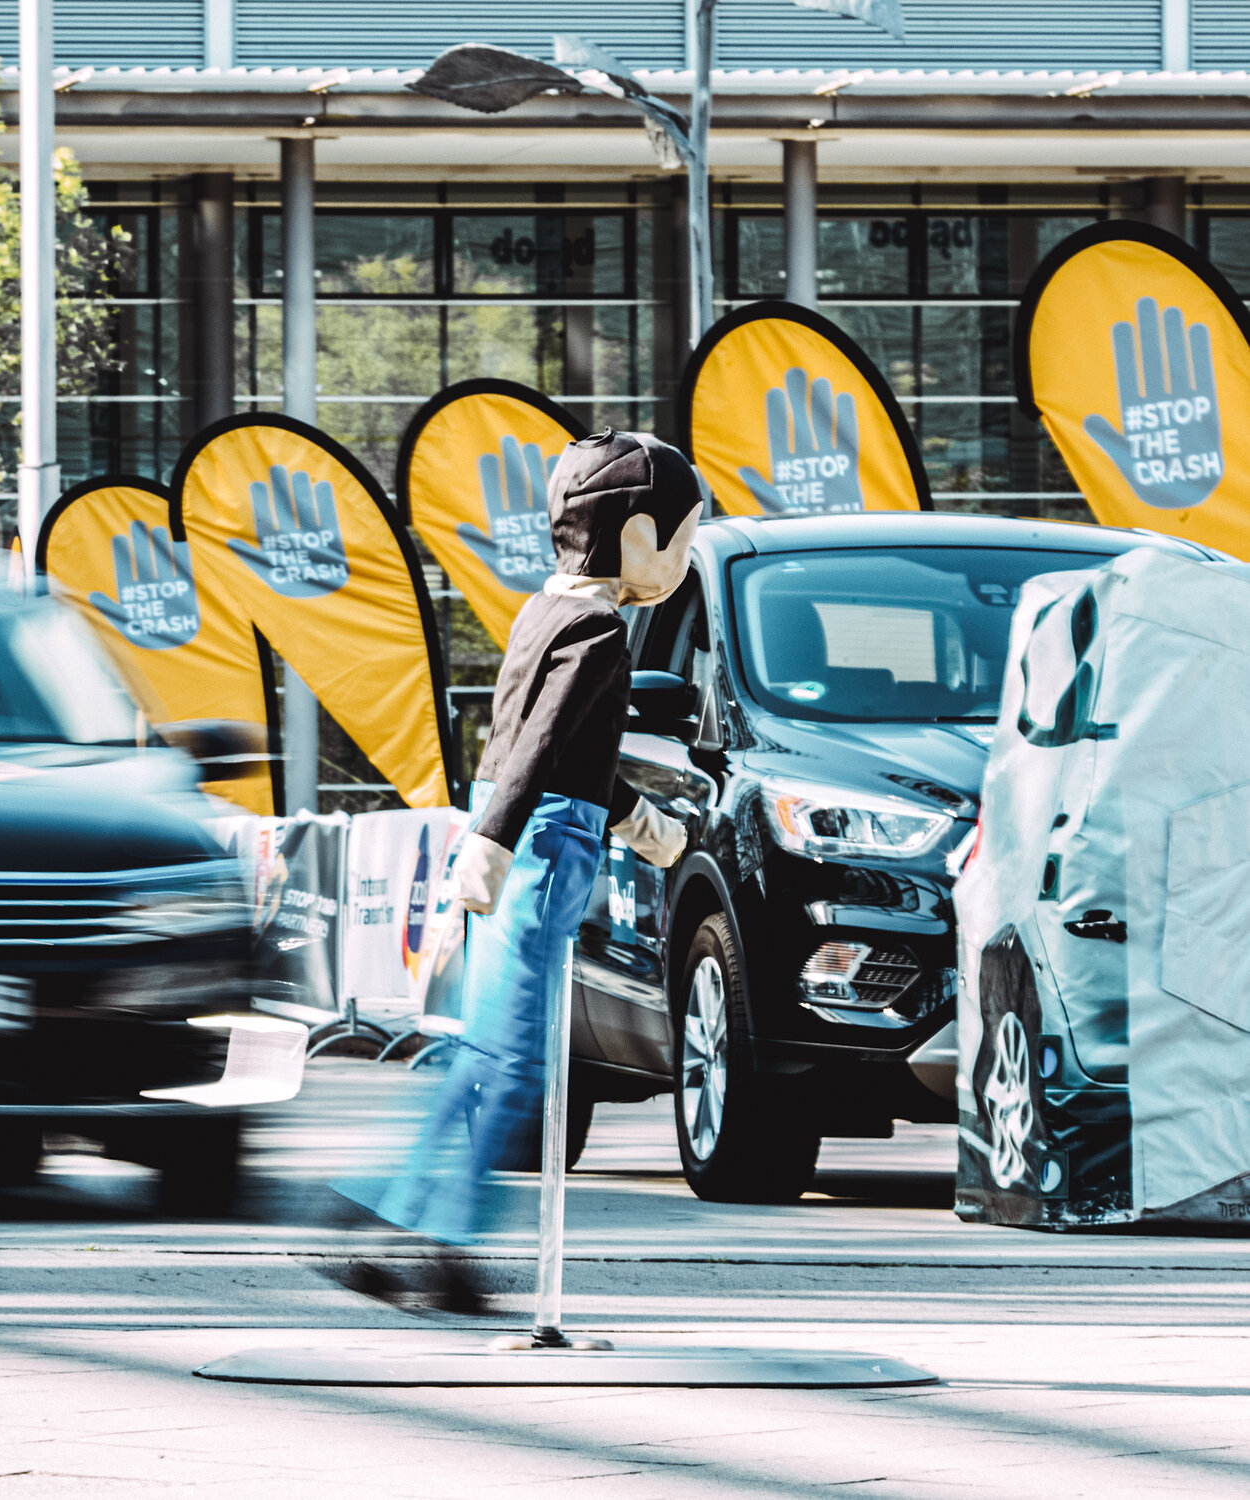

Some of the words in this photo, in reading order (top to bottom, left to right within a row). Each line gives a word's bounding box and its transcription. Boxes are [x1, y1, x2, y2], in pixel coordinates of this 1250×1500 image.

[1125, 395, 1211, 430] #STOP
[1127, 428, 1181, 459] THE
[775, 454, 850, 482] #STOP
[1134, 450, 1222, 485] CRASH
[774, 481, 824, 505] THE
[494, 511, 551, 535] #STO
[261, 530, 334, 550] #STOP
[494, 534, 542, 556] THE
[265, 550, 311, 567] THE
[498, 553, 557, 576] CRAS
[270, 563, 347, 584] CRASH
[121, 580, 190, 602] #STOP
[122, 600, 165, 619] THE
[126, 614, 197, 636] CRASH
